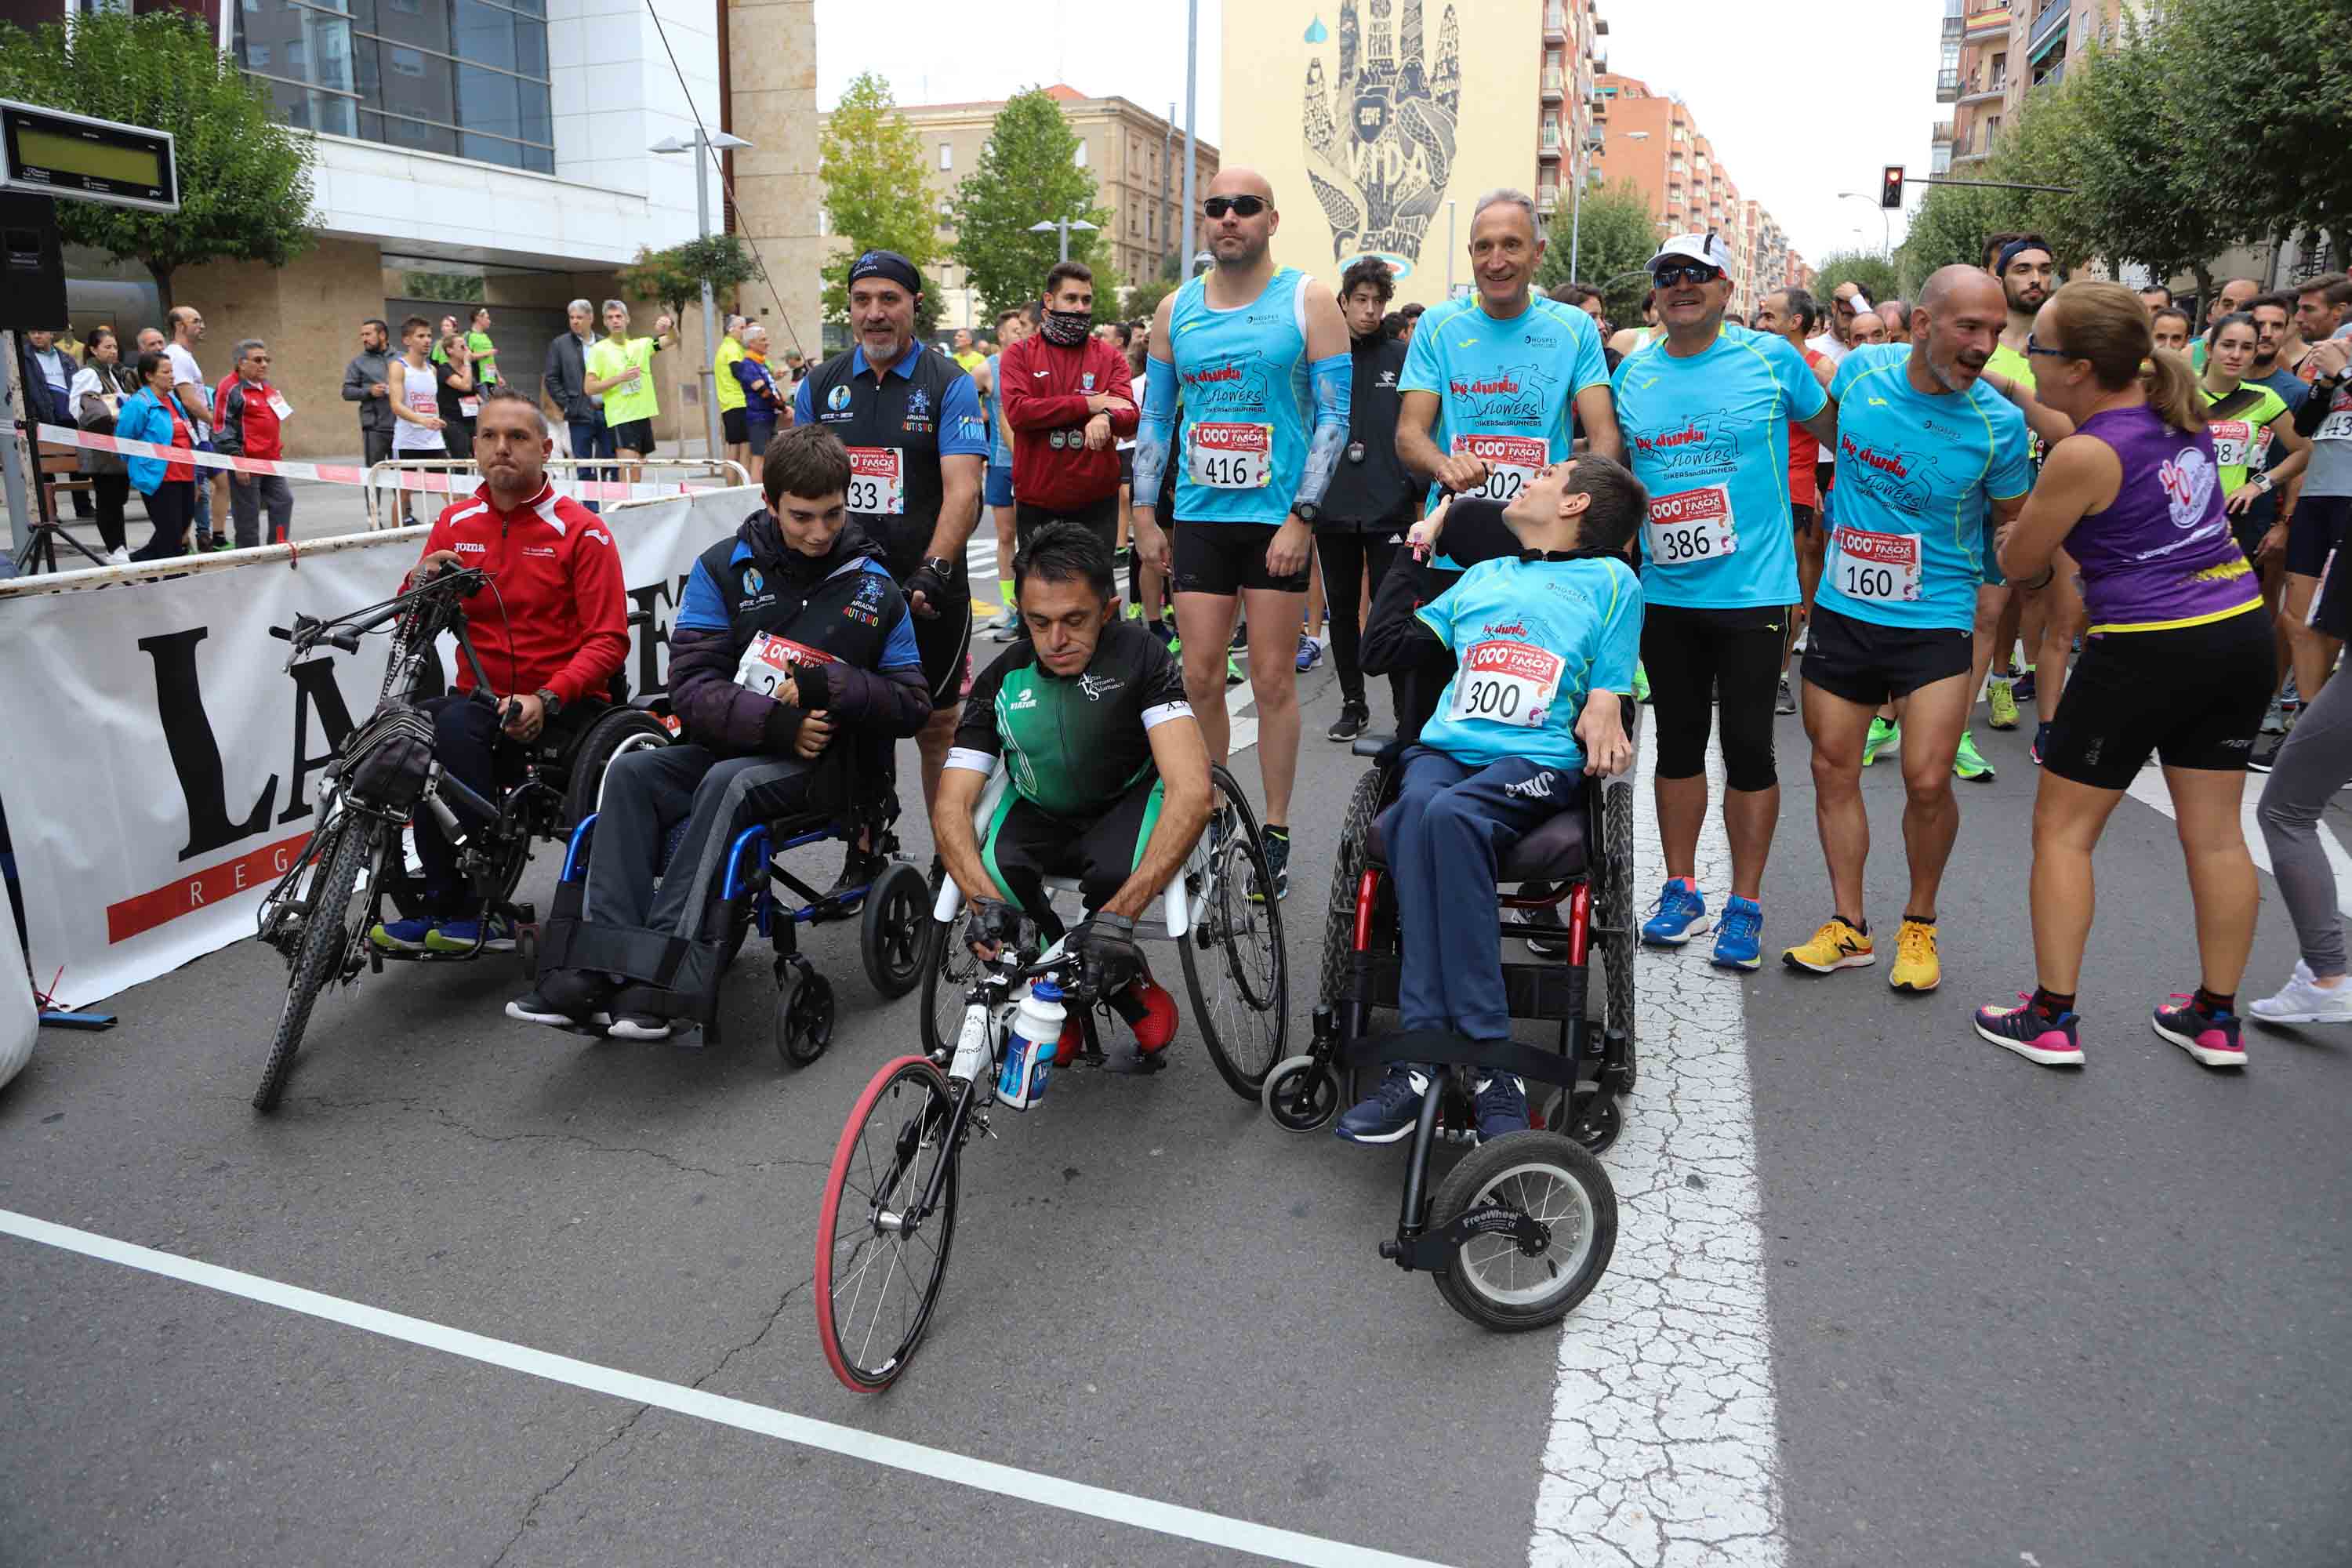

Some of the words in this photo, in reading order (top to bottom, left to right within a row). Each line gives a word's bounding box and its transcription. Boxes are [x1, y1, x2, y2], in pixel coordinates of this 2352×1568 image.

[902, 421, 933, 432] AUTISMO
[1205, 457, 1247, 485] 416
[847, 481, 878, 510] 33
[1662, 525, 1711, 561] 386
[1846, 565, 1893, 597] 160
[842, 606, 879, 627] AUTISMO
[851, 600, 878, 614] ARIADNA
[1469, 648, 1508, 669] 1.000
[1089, 681, 1125, 702] Salamanca
[1465, 681, 1520, 718] 300
[138, 626, 359, 862] LA
